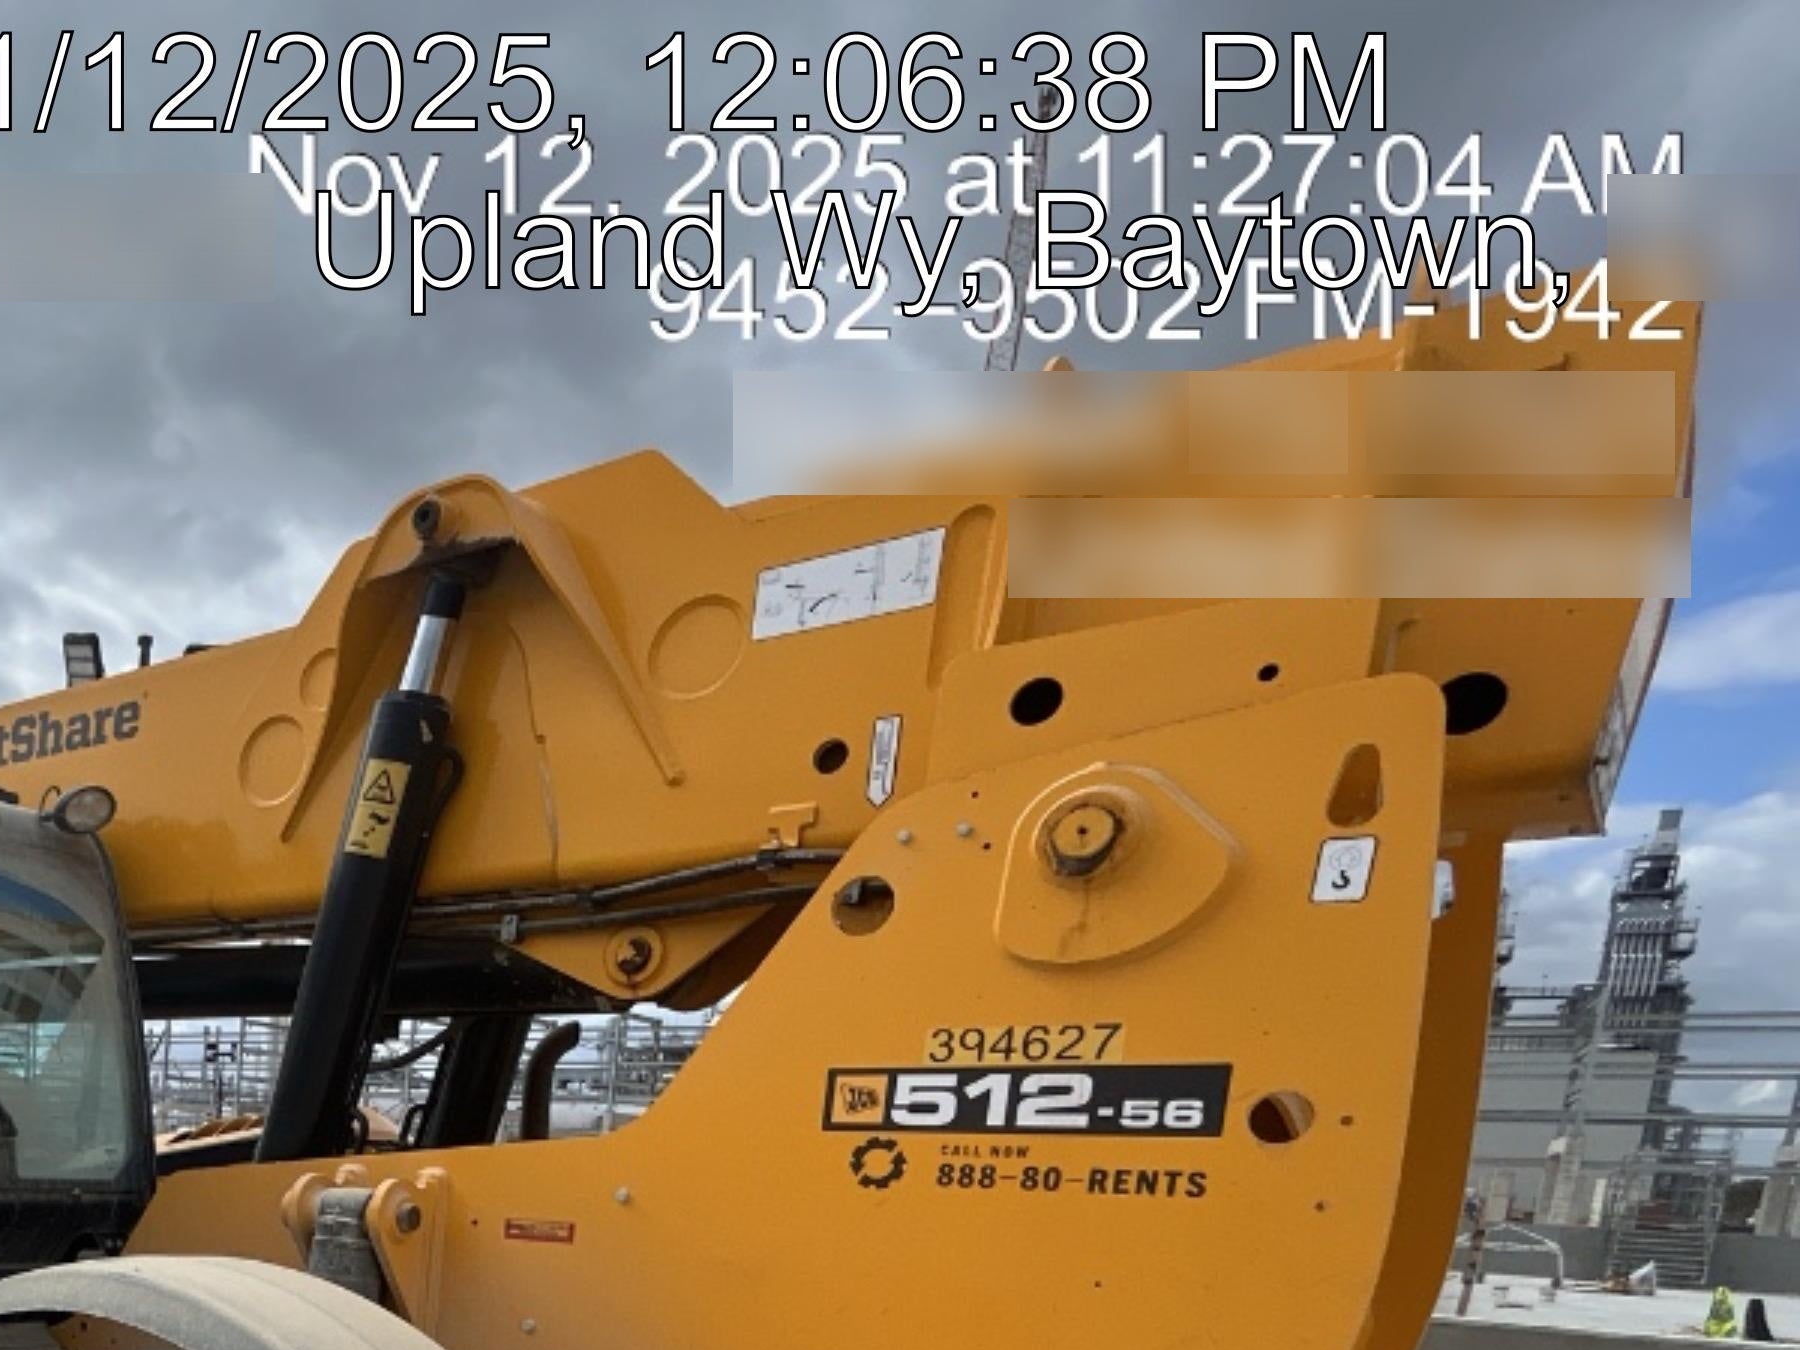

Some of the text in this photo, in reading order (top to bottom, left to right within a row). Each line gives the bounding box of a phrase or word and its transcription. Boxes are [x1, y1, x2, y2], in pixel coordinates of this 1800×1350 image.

[928, 1023, 1123, 1063] 394627
[890, 1073, 1204, 1129] 512-56
[989, 1145, 1030, 1159] NOW
[936, 1162, 1208, 1198] 888-80-RENTS
